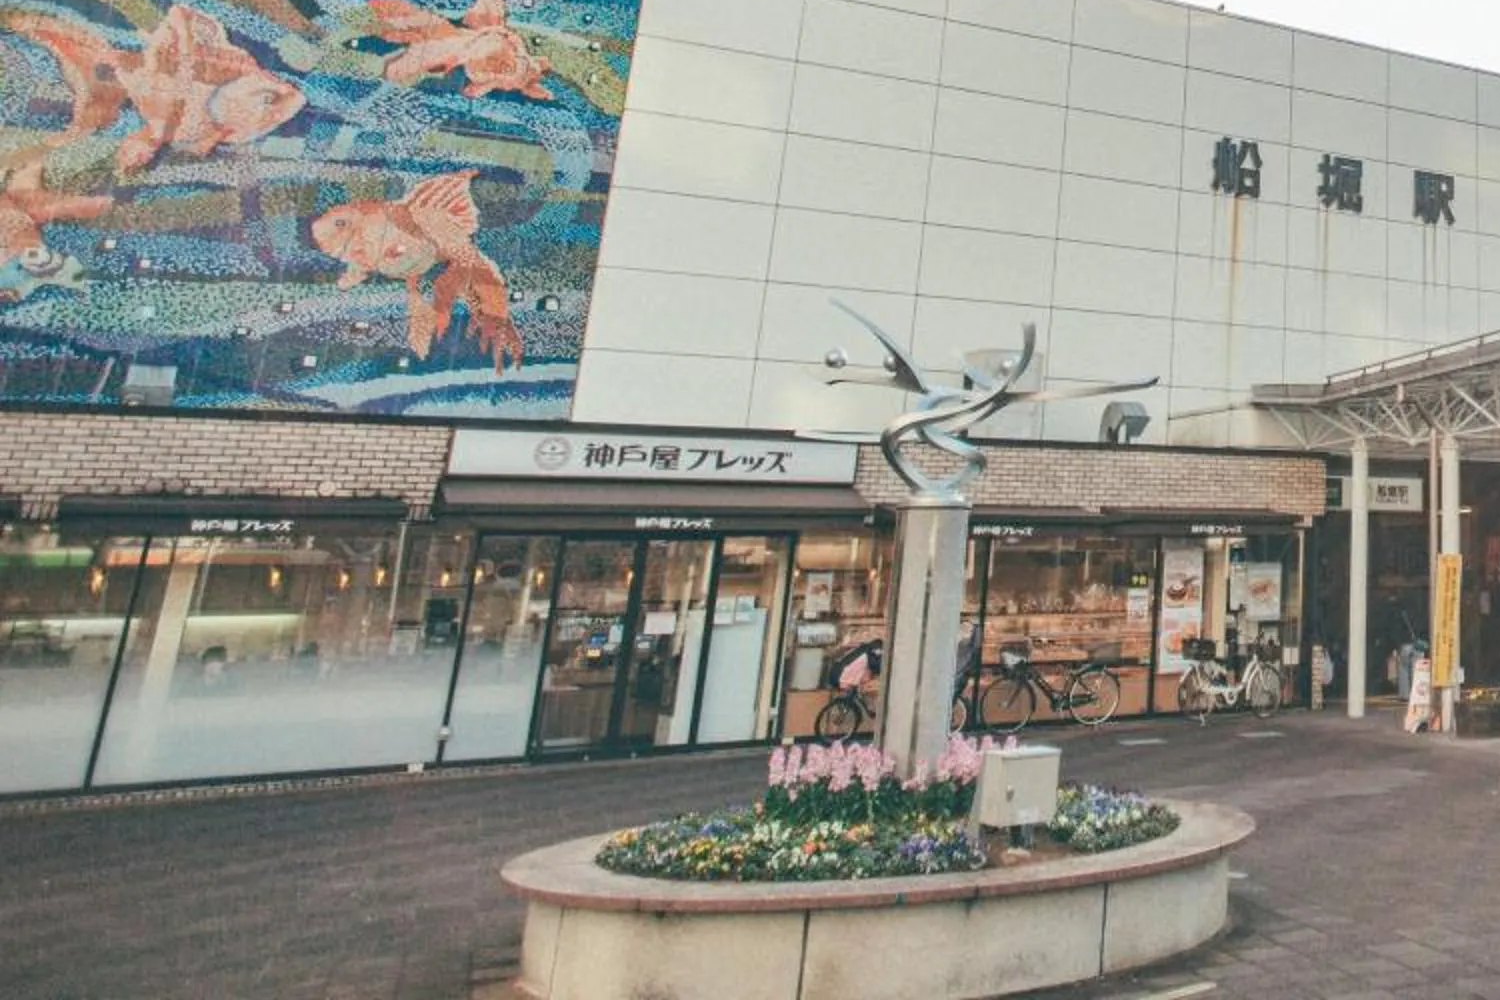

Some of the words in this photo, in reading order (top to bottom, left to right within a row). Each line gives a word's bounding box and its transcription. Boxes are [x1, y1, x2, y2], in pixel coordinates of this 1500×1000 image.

[1211, 136, 1456, 226] 船堀駅
[583, 442, 794, 474] 神戸屋ブレッズ
